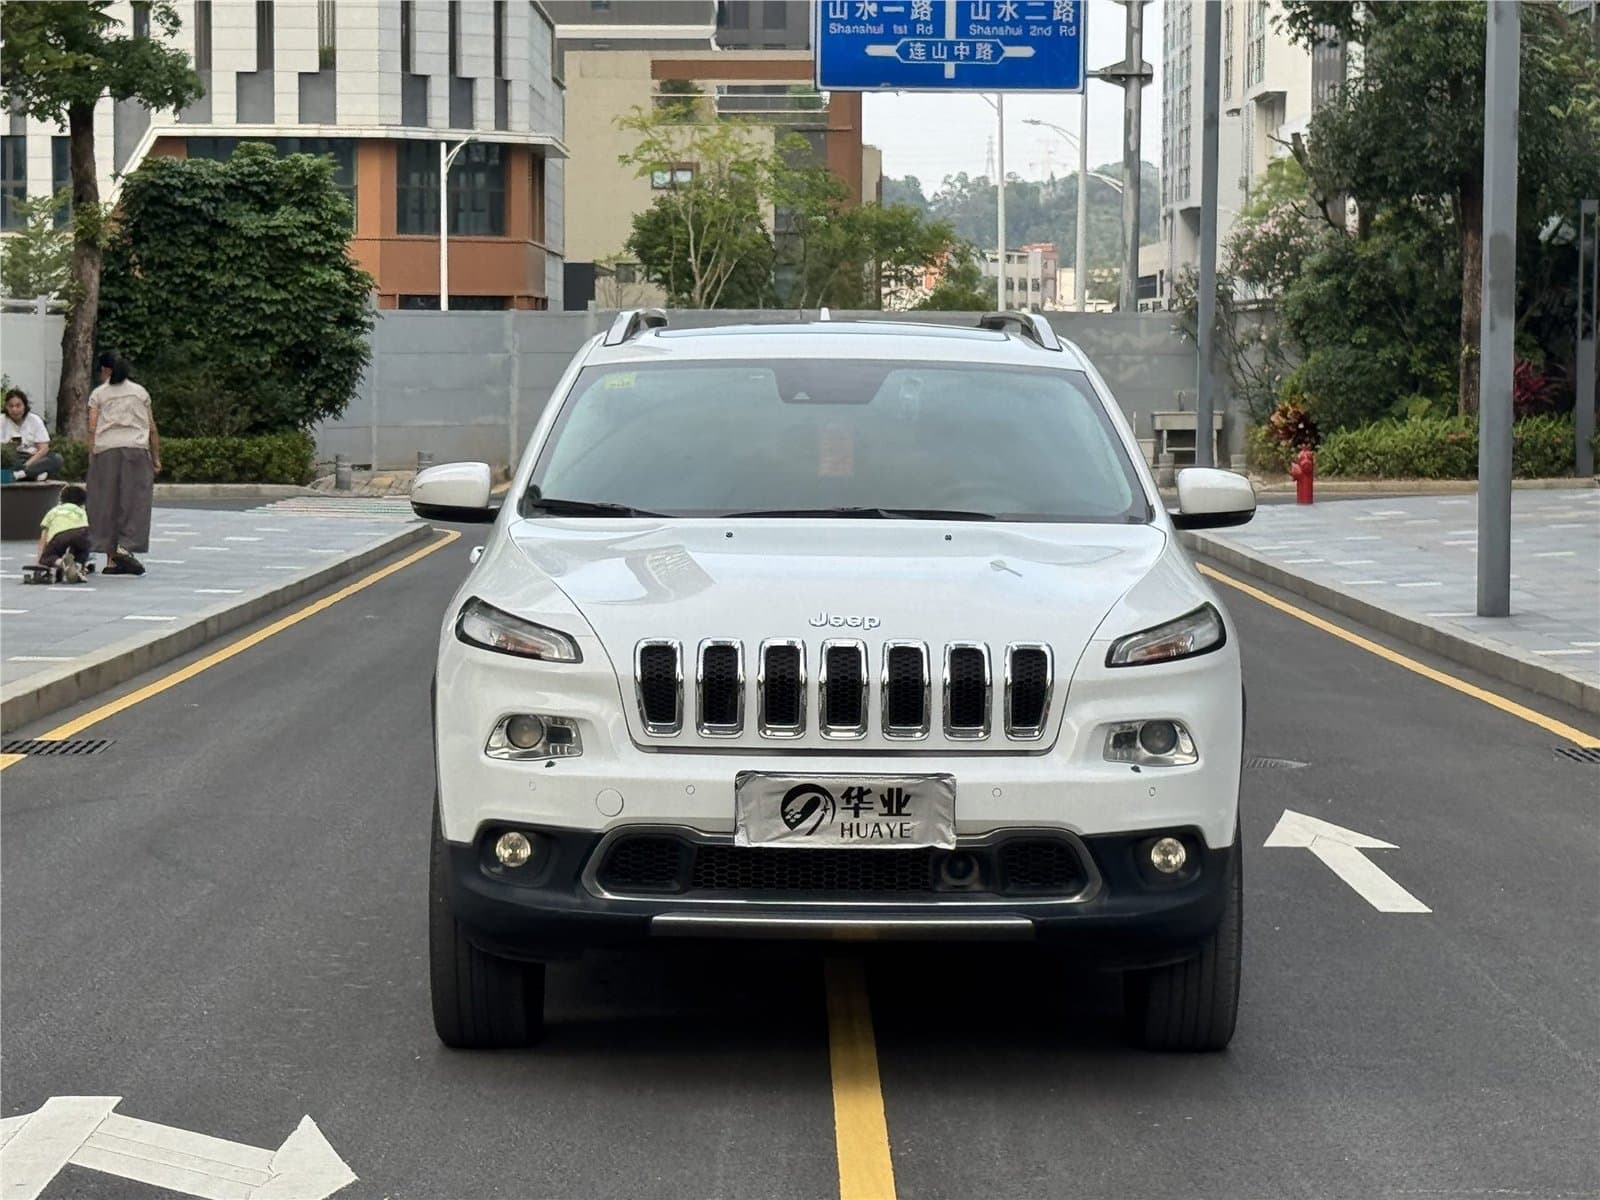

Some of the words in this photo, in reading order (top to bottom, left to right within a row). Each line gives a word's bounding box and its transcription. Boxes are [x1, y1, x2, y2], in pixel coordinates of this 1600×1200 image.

[828, 0, 934, 21] 山水一路
[970, 0, 1074, 22] 山水二路
[829, 23, 884, 34] Shanshui
[916, 24, 934, 35] Rd
[969, 24, 1022, 36] Shanshui
[1029, 25, 1052, 36] 2nd
[1059, 25, 1076, 36] Rd
[909, 42, 993, 60] 连山中路
[808, 611, 881, 630] Jeep
[840, 786, 912, 818] 华业
[840, 822, 911, 839] HUAYE
